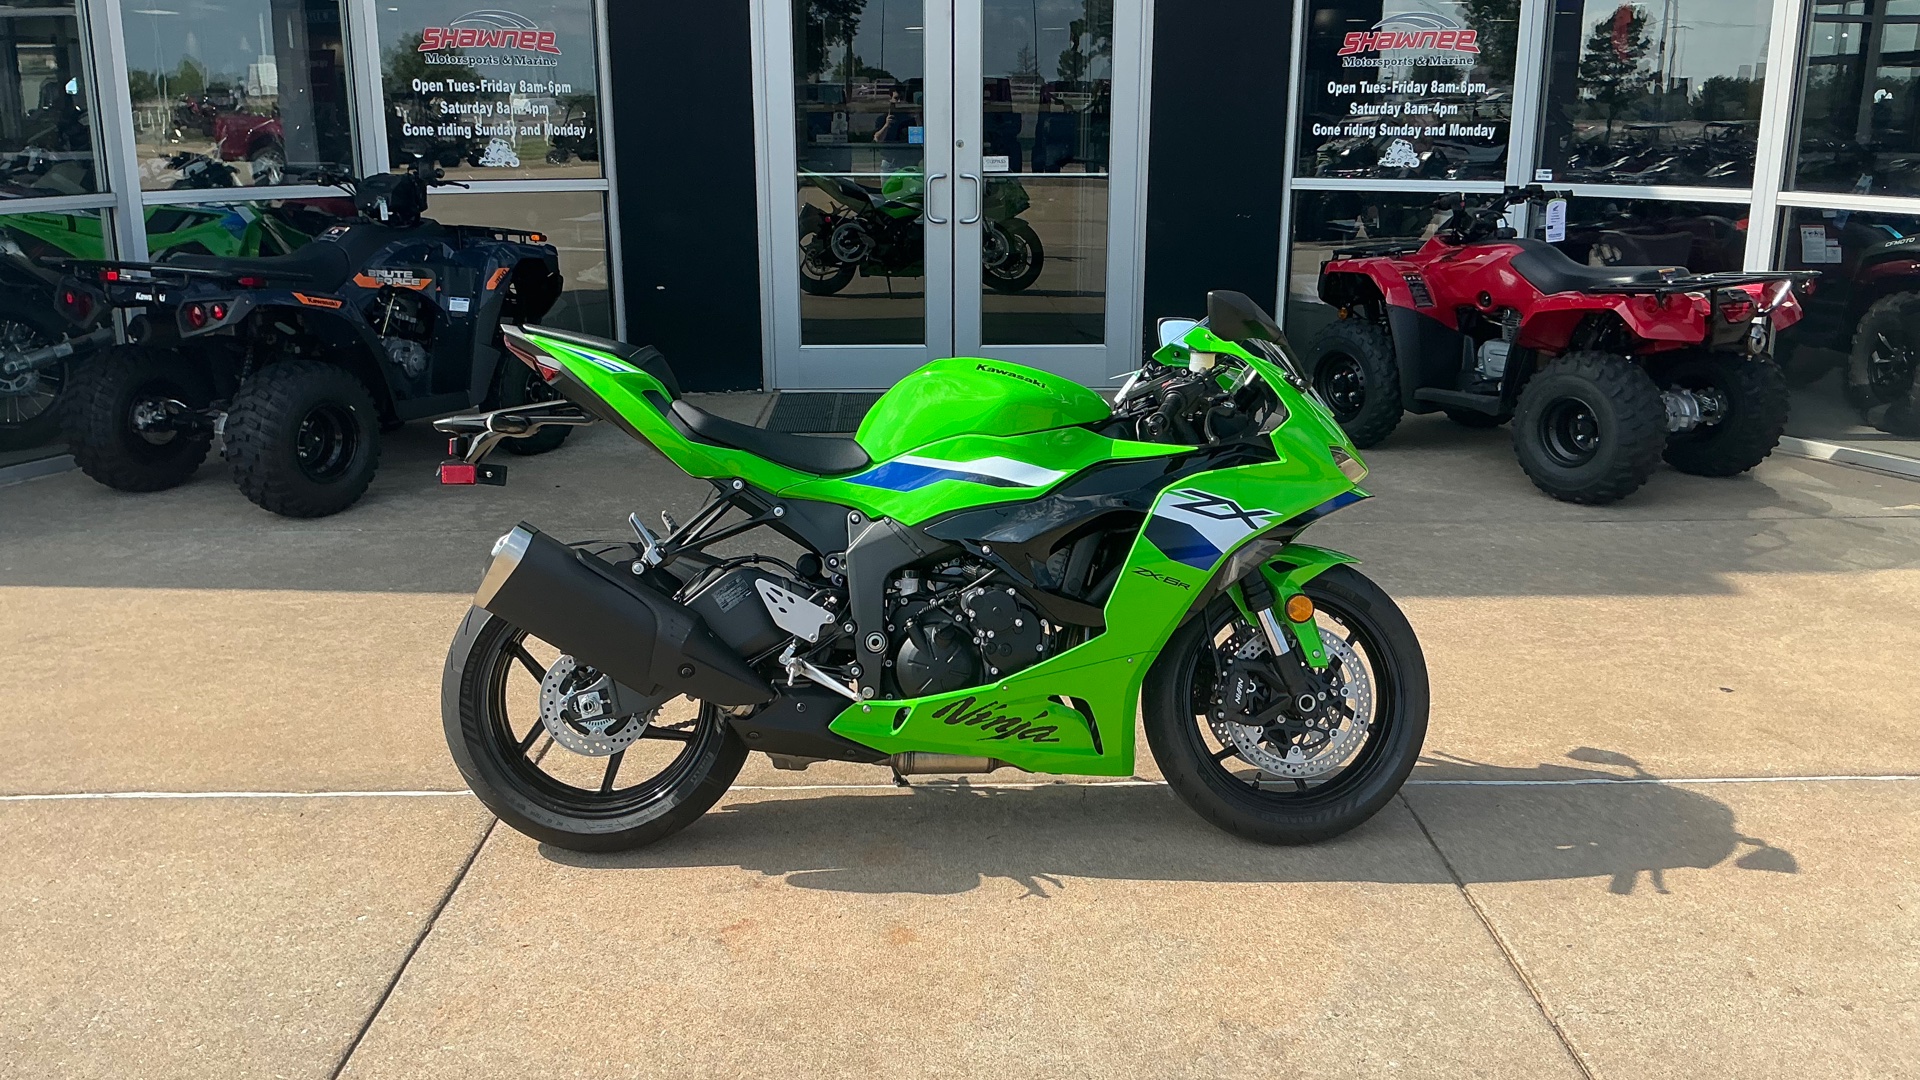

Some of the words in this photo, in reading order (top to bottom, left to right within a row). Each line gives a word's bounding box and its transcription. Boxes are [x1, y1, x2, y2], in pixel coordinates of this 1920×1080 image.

[425, 53, 499, 67] Motorsports
[502, 54, 511, 65] &
[514, 55, 557, 66] Marine
[1342, 56, 1414, 69] Motorsports
[1416, 56, 1426, 66] &
[1429, 55, 1474, 66] Marine
[412, 79, 443, 95] Open
[446, 79, 516, 95] Tues-Friday
[519, 80, 572, 96] 8am-6pm
[1327, 81, 1356, 96] Open
[1360, 80, 1428, 96] Tues-Friday
[1430, 80, 1486, 96] 8am-6pm
[440, 101, 493, 117] Saturday
[1350, 102, 1401, 118] Saturday
[1404, 101, 1458, 117] 8am-4pm
[402, 123, 434, 136] Gone
[438, 123, 472, 139] riding
[475, 123, 516, 139] Sunday
[520, 123, 541, 136] and
[545, 123, 587, 139] Monday
[1312, 123, 1341, 136] Gone
[1344, 123, 1376, 139] riding
[1379, 123, 1421, 139] Sunday
[1424, 123, 1446, 136] and
[1449, 123, 1496, 139] Monday
[1885, 237, 1916, 248] CFMOTO
[367, 269, 413, 279] BRUTE
[375, 278, 421, 286] FORCE
[976, 363, 1047, 389] Kawasaki
[1169, 490, 1276, 530] ZX
[1131, 566, 1191, 591] ZX-6R
[931, 696, 1060, 743] Ninja
